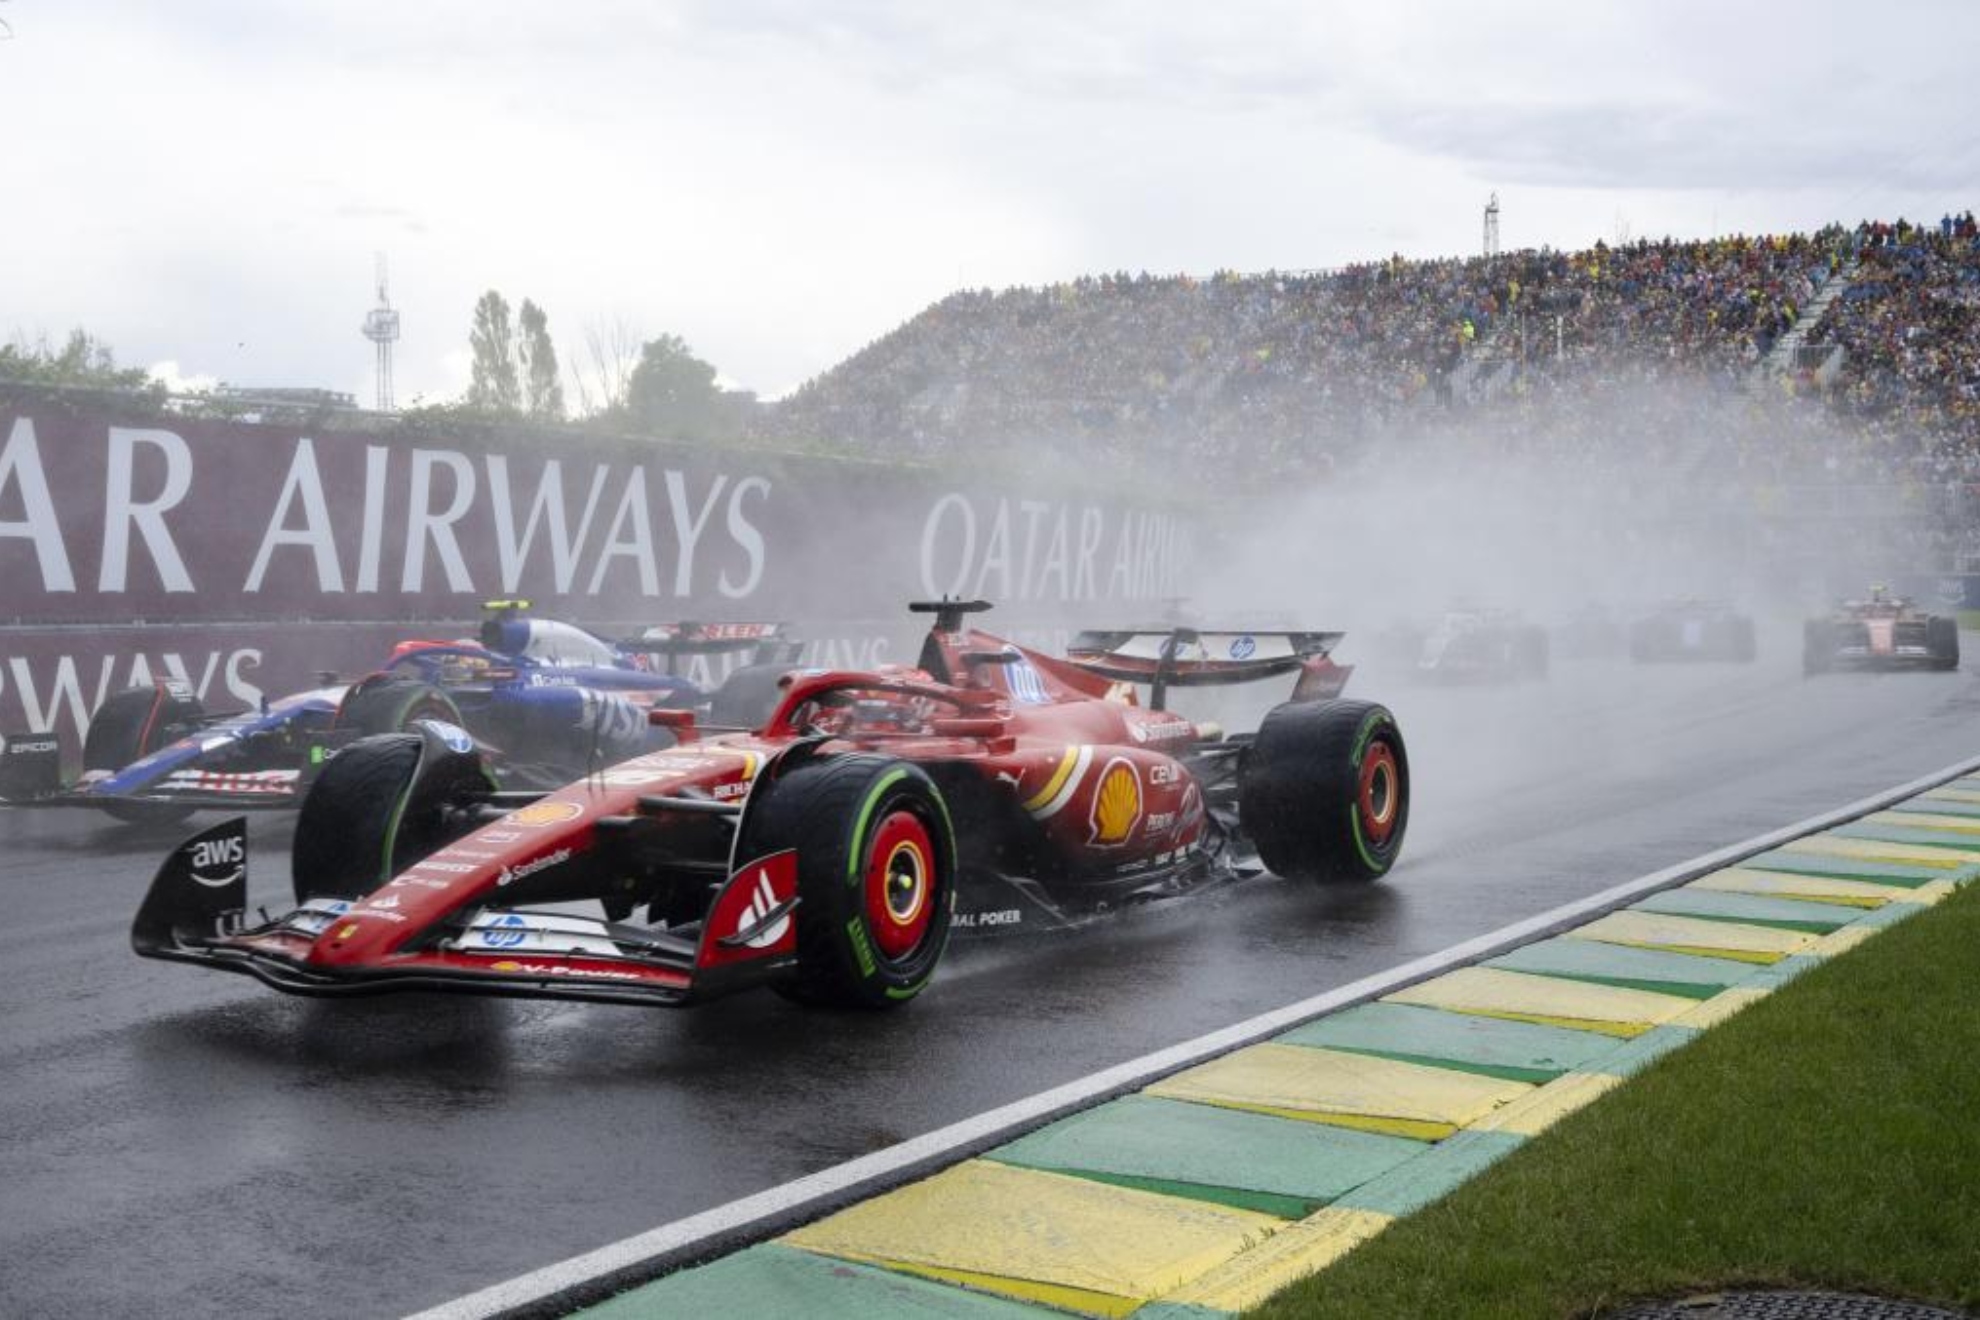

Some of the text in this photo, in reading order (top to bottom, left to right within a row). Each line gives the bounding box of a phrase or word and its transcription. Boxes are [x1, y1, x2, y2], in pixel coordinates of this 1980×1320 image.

[243, 437, 772, 598] AIRWAYS
[920, 493, 1102, 602] QATAR
[193, 836, 244, 868] aws
[979, 909, 1021, 926] POKER
[522, 963, 641, 980] V-Power
